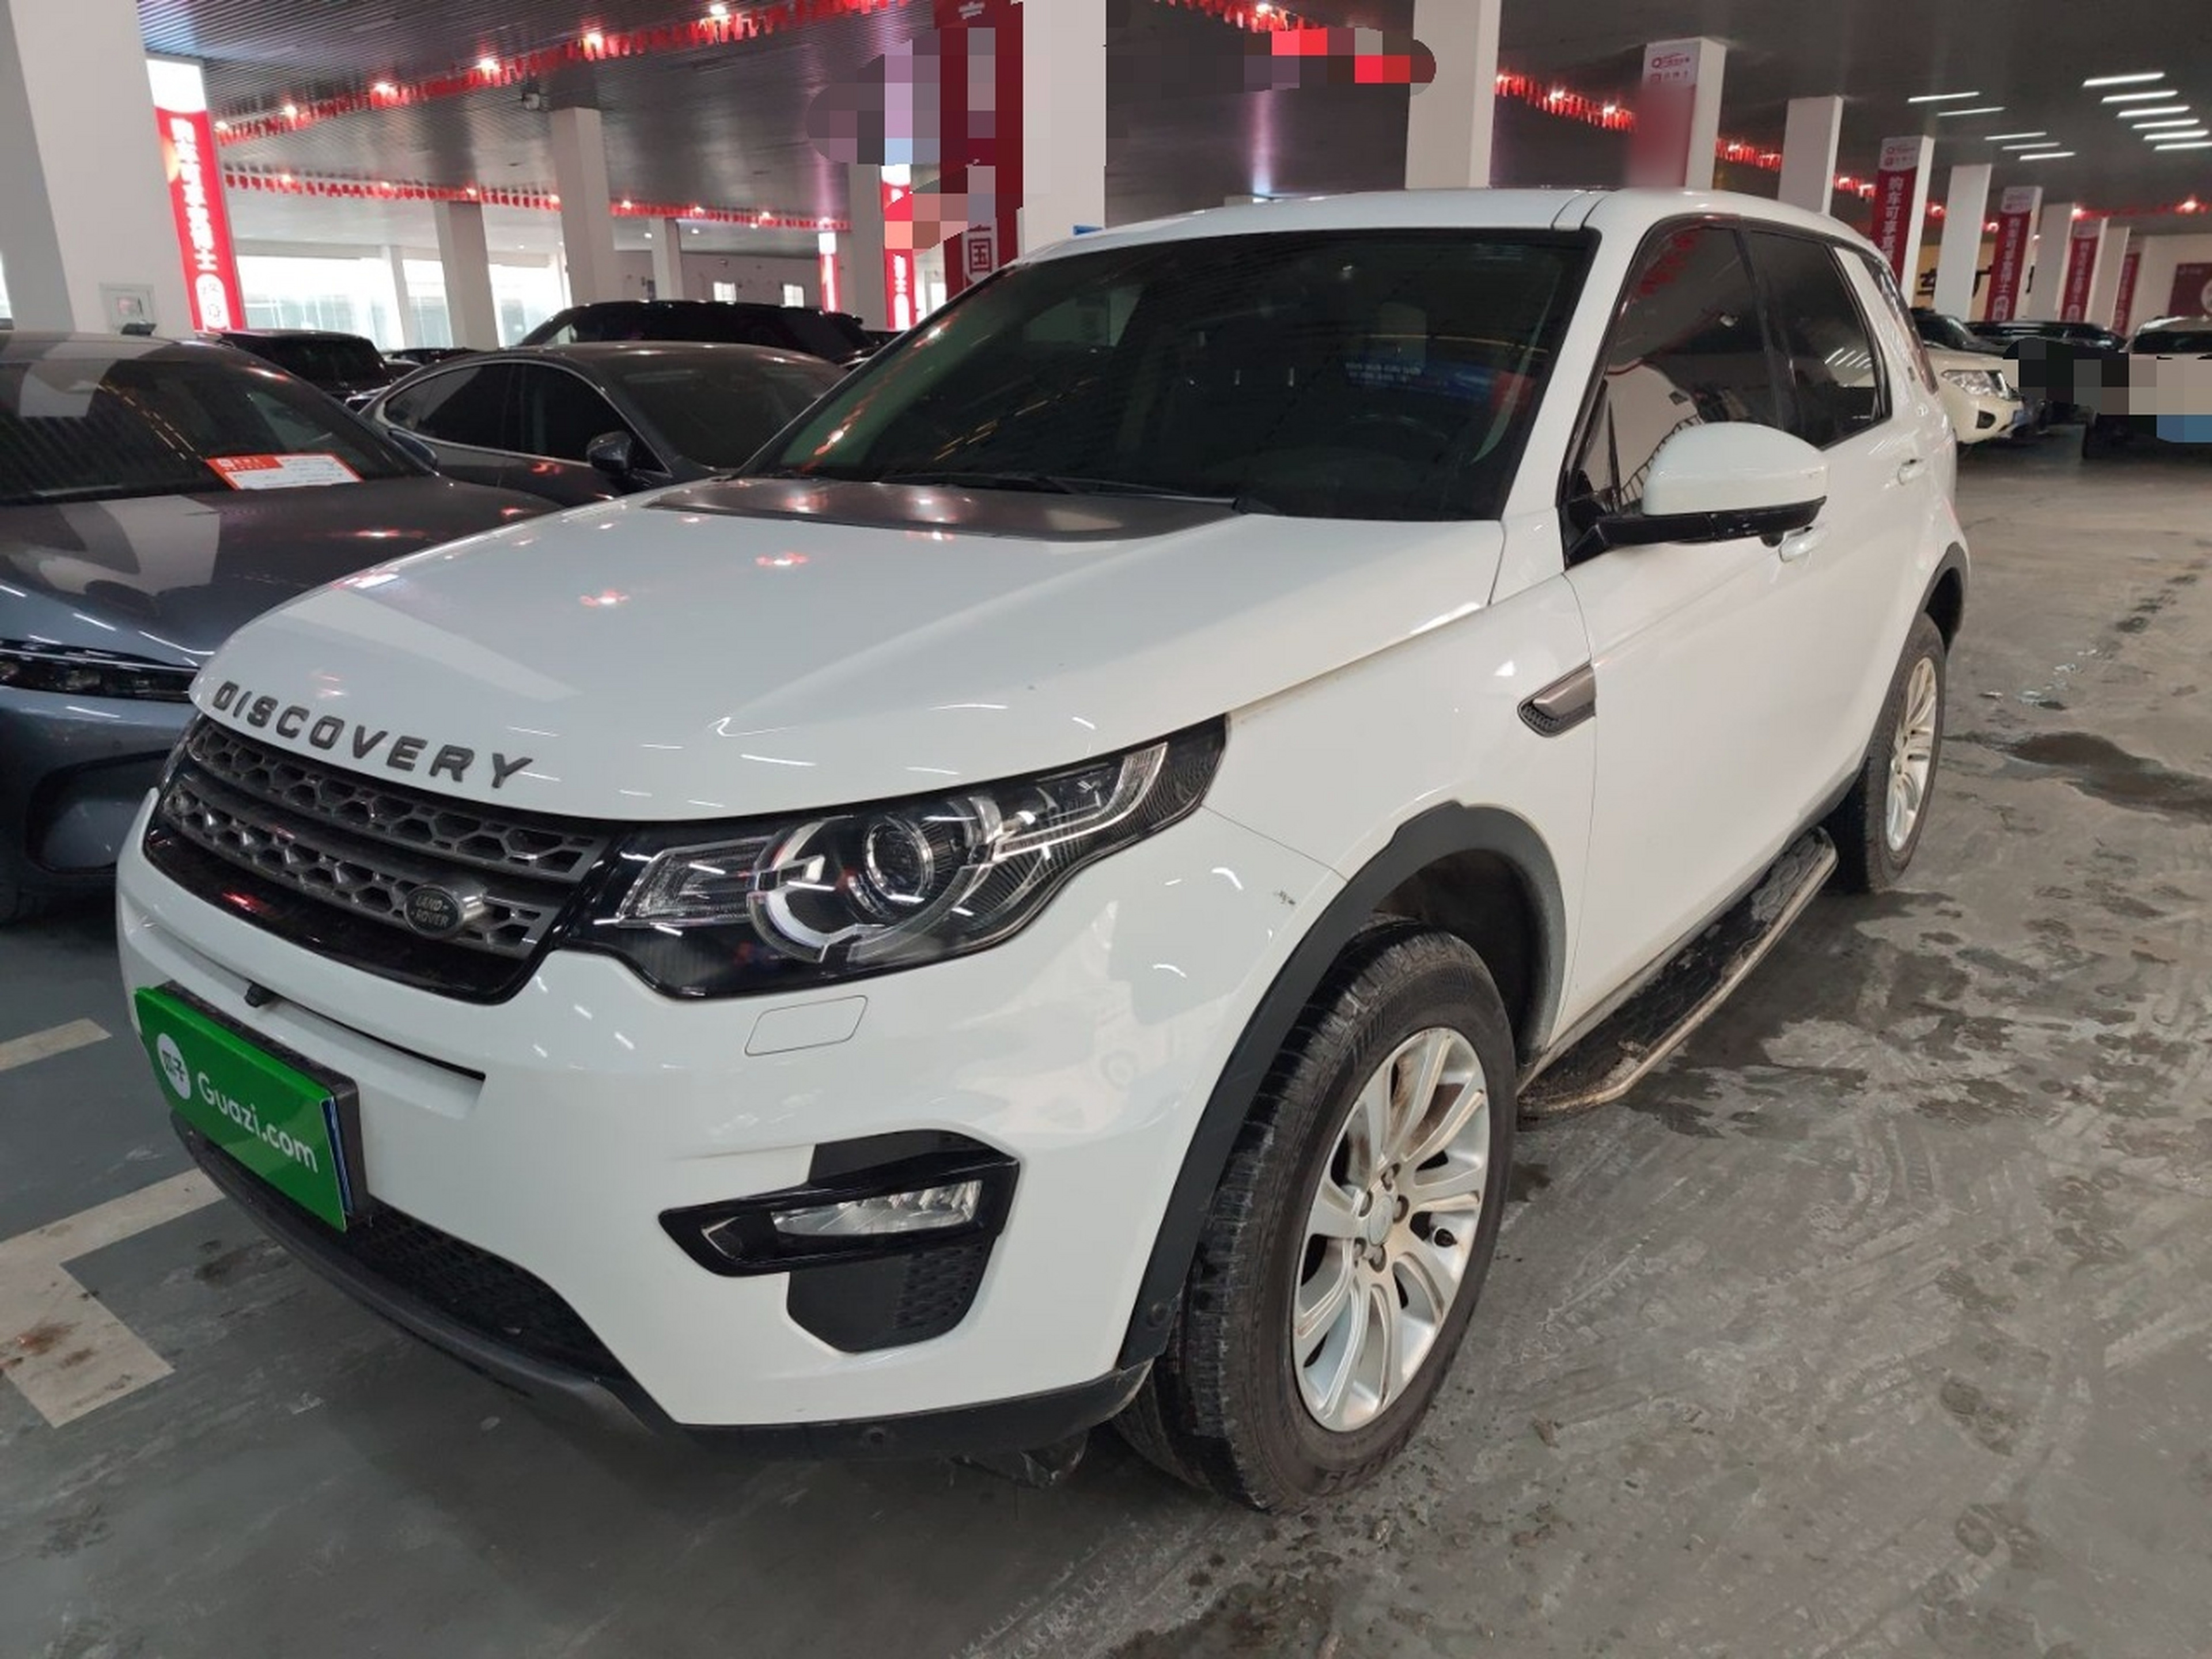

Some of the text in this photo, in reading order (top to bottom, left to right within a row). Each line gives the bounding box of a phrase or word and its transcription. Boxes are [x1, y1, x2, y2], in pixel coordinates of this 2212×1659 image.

[212, 680, 533, 789] DISCOVERY
[415, 896, 443, 911] LAND
[416, 909, 449, 928] ROVER
[198, 1071, 319, 1173] Guazi.com
